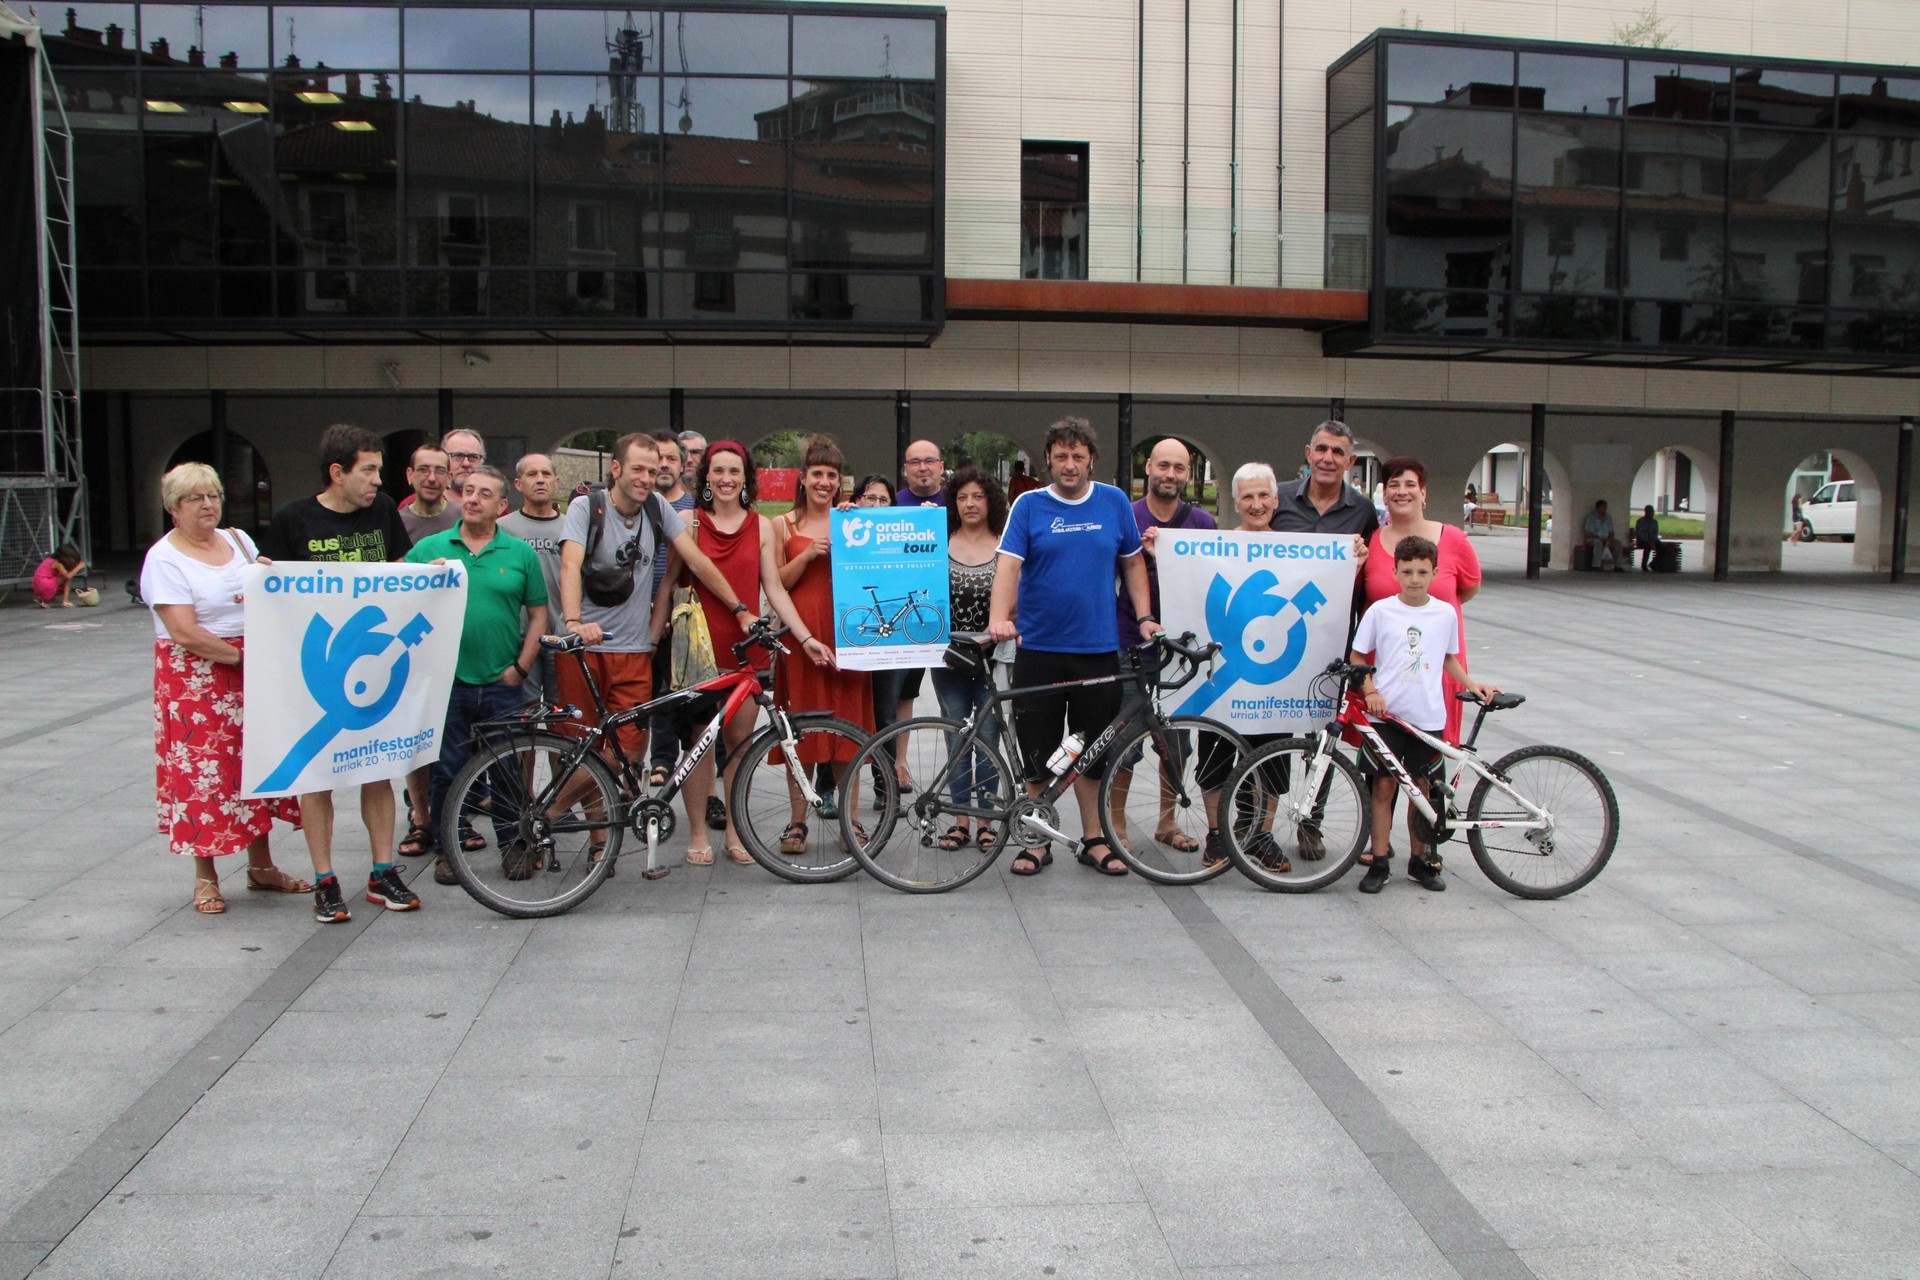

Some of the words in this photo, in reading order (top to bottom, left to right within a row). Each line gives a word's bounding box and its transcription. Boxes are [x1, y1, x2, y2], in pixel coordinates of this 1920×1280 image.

[875, 519, 915, 533] orain
[876, 529, 936, 545] presoak
[903, 543, 938, 553] tour
[1174, 536, 1239, 557] orain
[1247, 541, 1347, 562] presoak
[264, 569, 343, 593] orain
[353, 568, 462, 599] presoak
[1231, 696, 1333, 709] manifestazioa
[1230, 710, 1259, 719] urriak
[1261, 710, 1272, 719] 20
[1279, 709, 1303, 718] 17:00
[1311, 709, 1332, 719] Bilbo
[333, 728, 434, 762] manifestazioa
[332, 759, 363, 773] urriak
[365, 755, 379, 767] 20
[387, 749, 413, 762] 17:00
